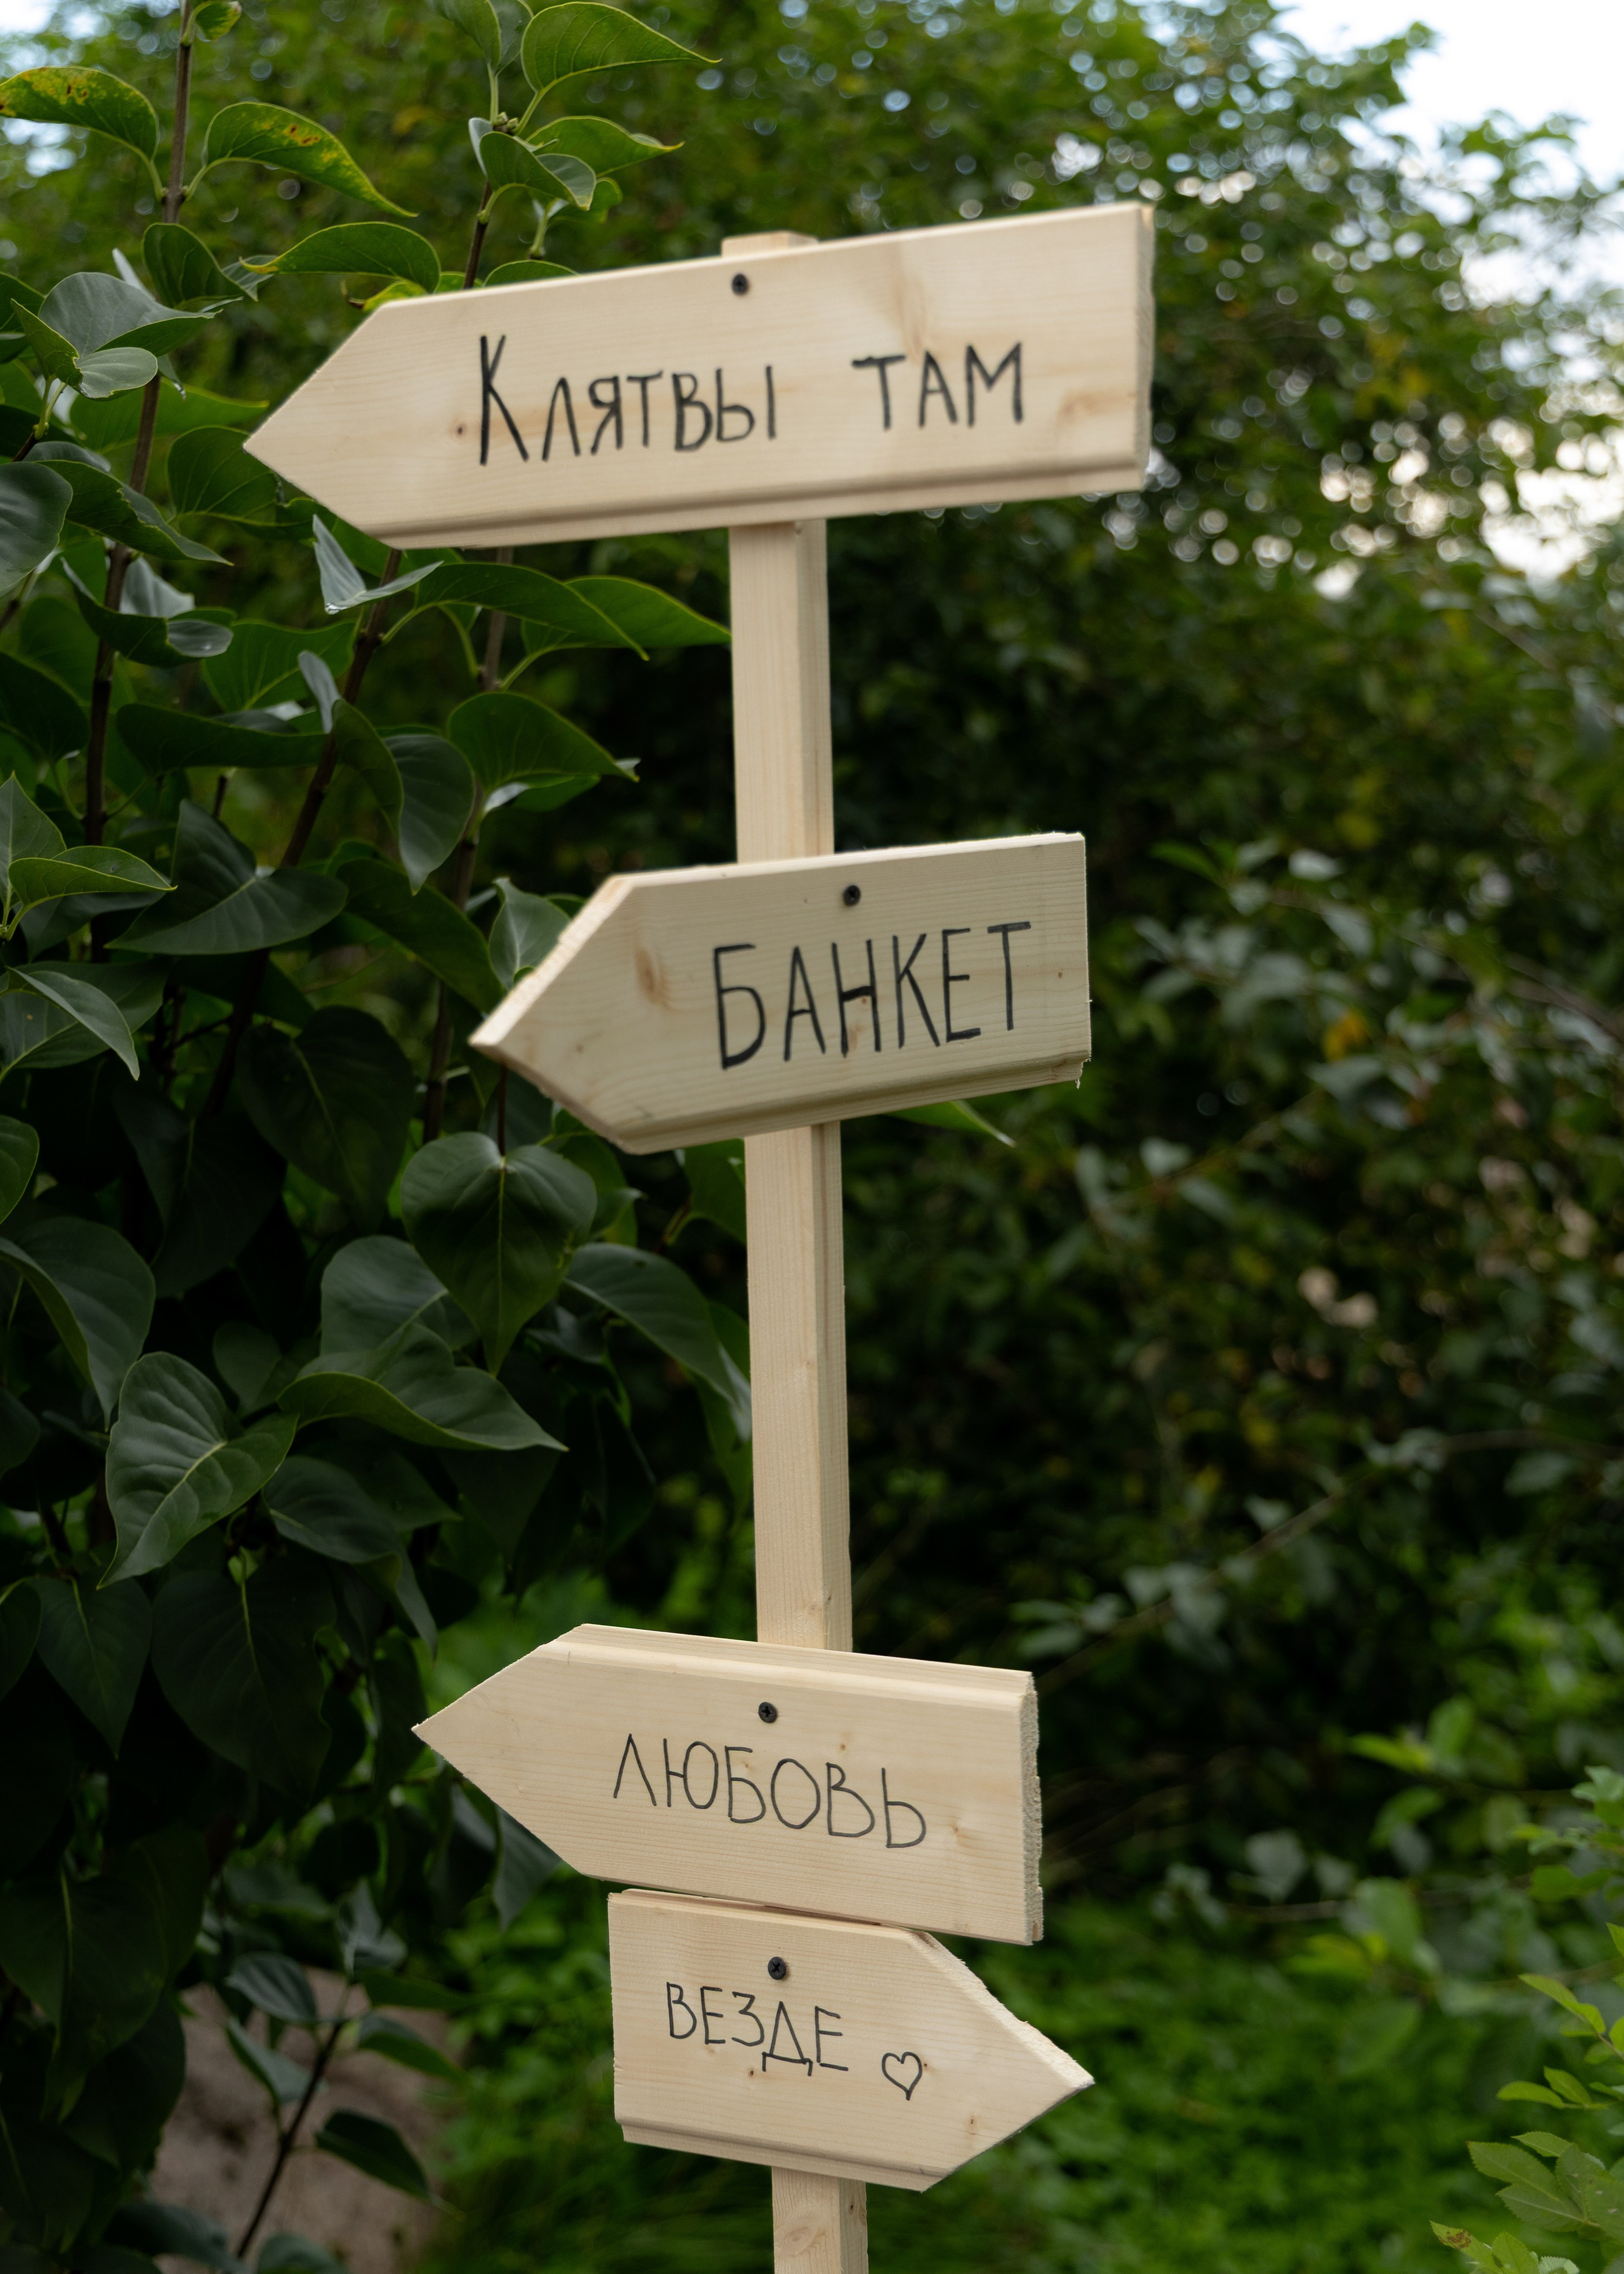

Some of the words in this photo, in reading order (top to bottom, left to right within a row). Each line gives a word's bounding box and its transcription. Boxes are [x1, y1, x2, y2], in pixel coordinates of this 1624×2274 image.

[712, 919, 1033, 1071] БАНКЕТ
[612, 1732, 927, 1850] ЛЮБОВЬ
[665, 1980, 849, 2079] ВЕЗДЕ
